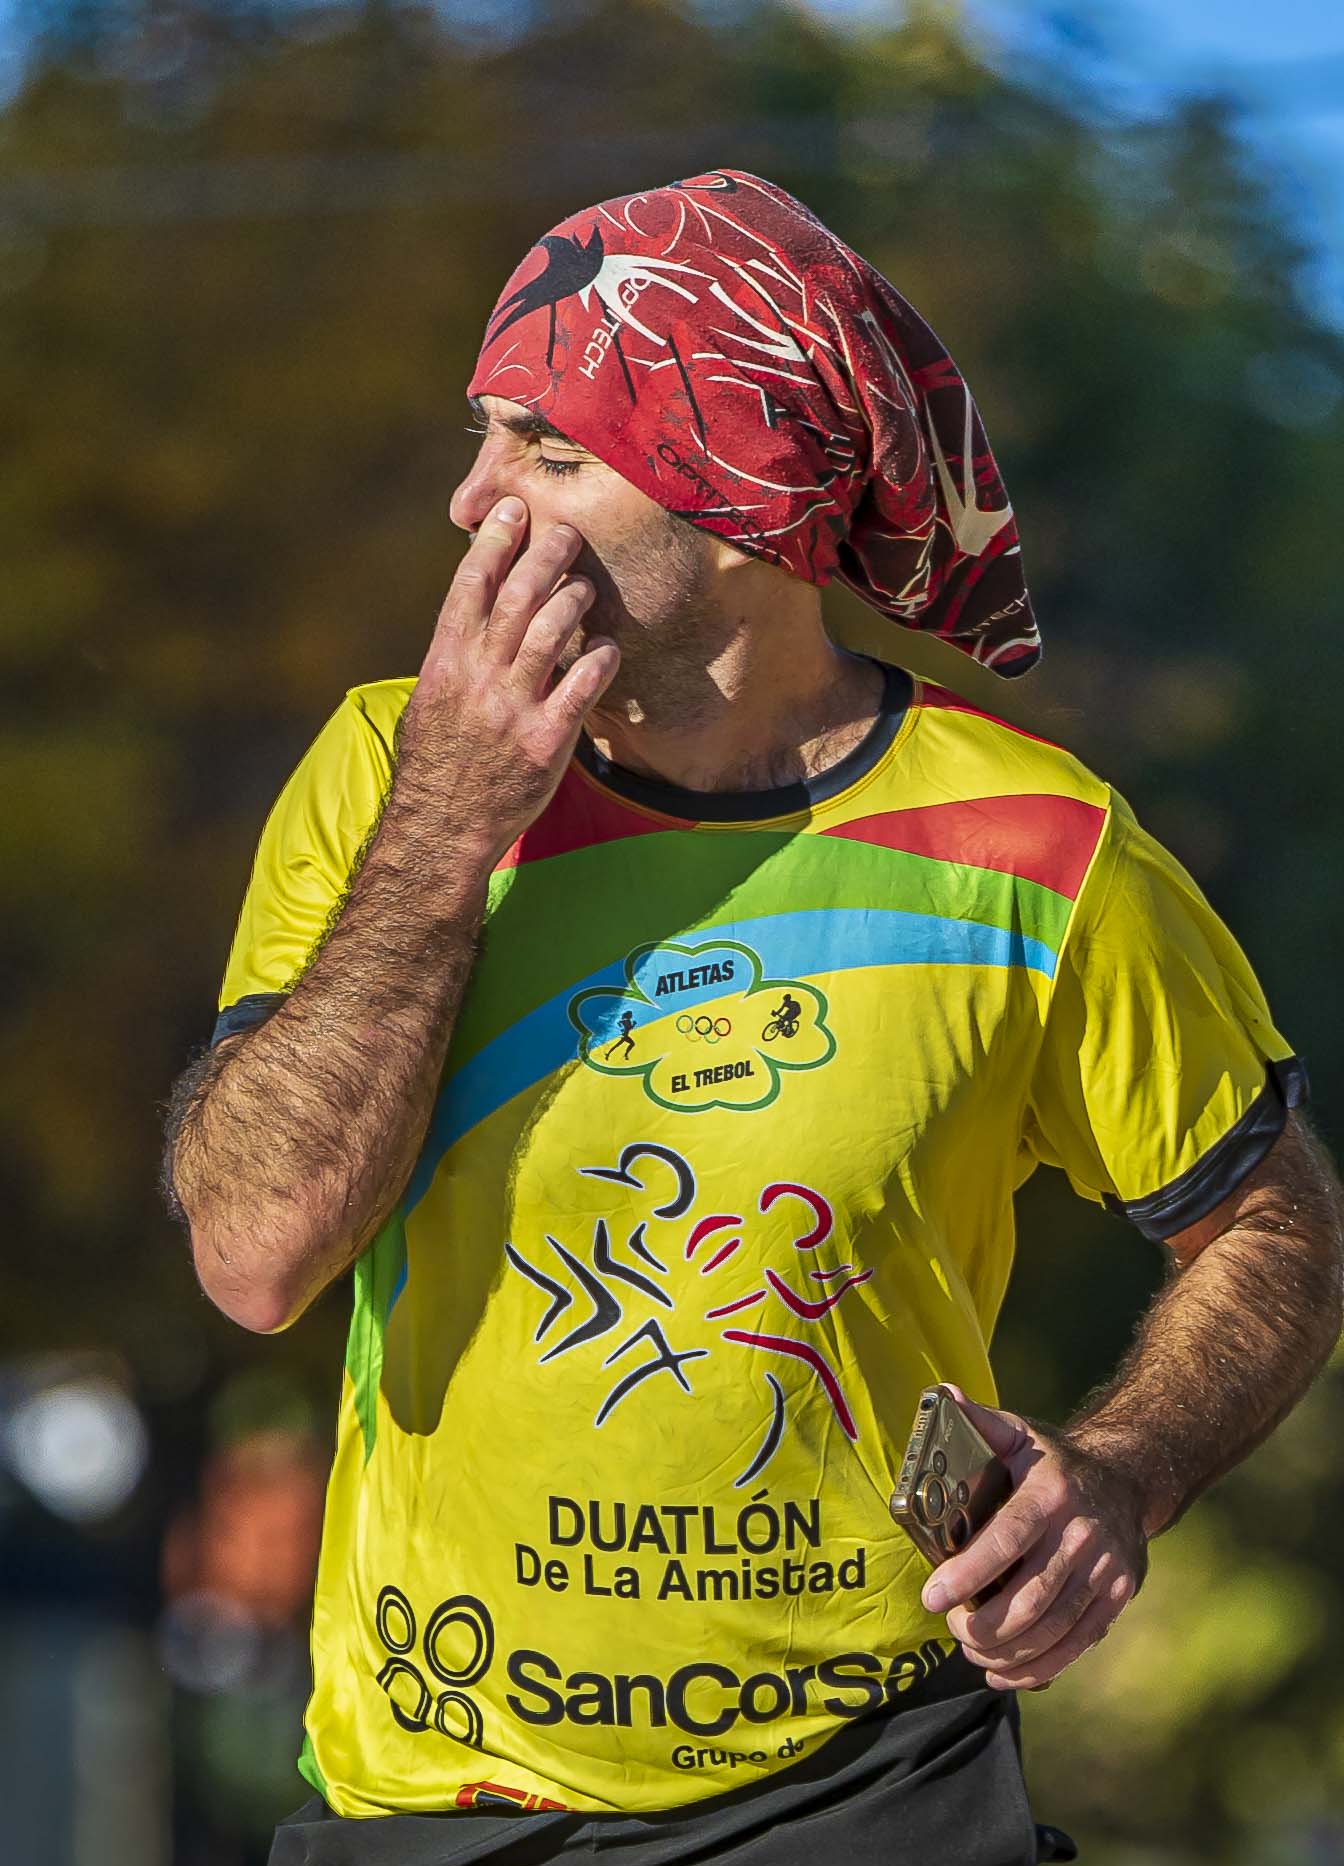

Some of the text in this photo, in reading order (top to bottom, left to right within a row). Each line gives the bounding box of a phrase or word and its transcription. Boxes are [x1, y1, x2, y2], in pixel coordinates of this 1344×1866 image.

[656, 959, 734, 996] ATLETAS
[671, 1060, 755, 1093] EL TREBOL
[548, 1488, 822, 1555] DUATLÓN
[515, 1543, 866, 1601] De La Amistad
[671, 1744, 767, 1769] Grupo
